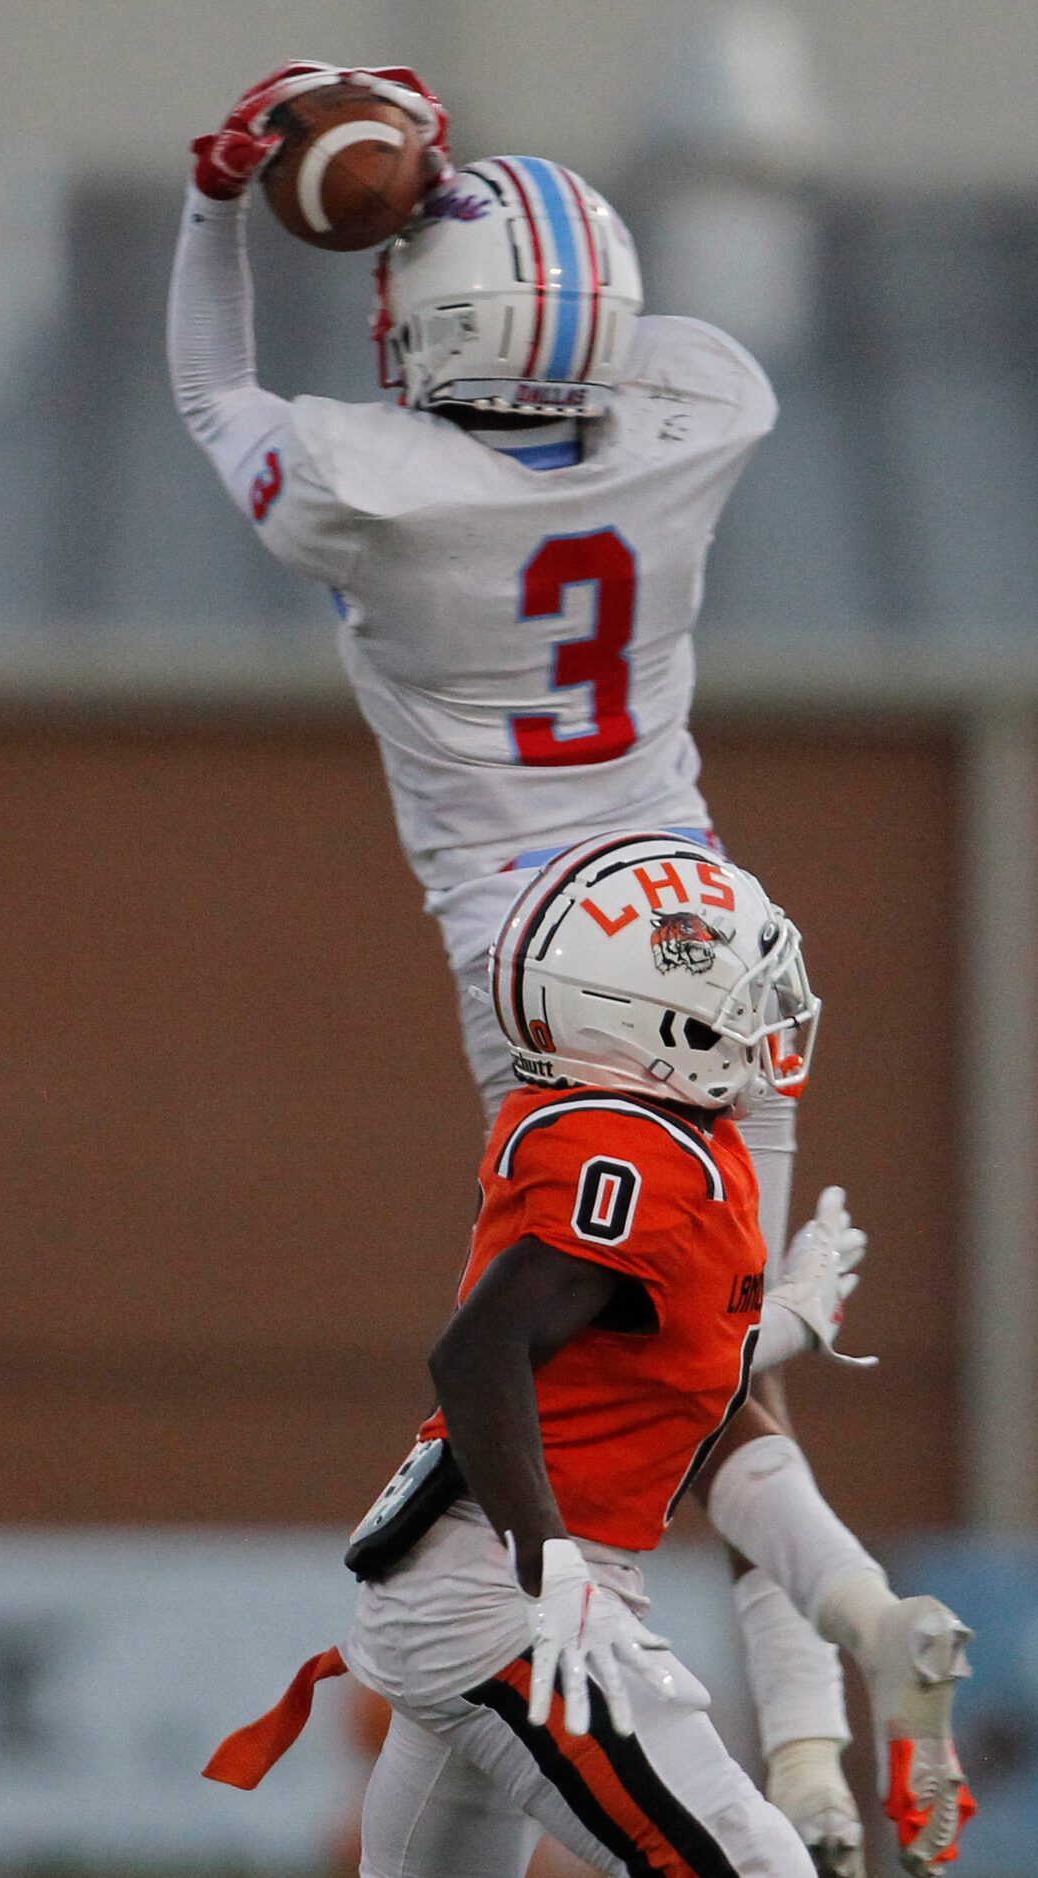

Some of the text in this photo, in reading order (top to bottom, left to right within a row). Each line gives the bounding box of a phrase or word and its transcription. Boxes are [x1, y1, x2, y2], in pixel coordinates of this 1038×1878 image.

[250, 447, 283, 525] 3
[507, 524, 640, 767] 3
[580, 862, 736, 937] LHS
[570, 1155, 643, 1247] 0
